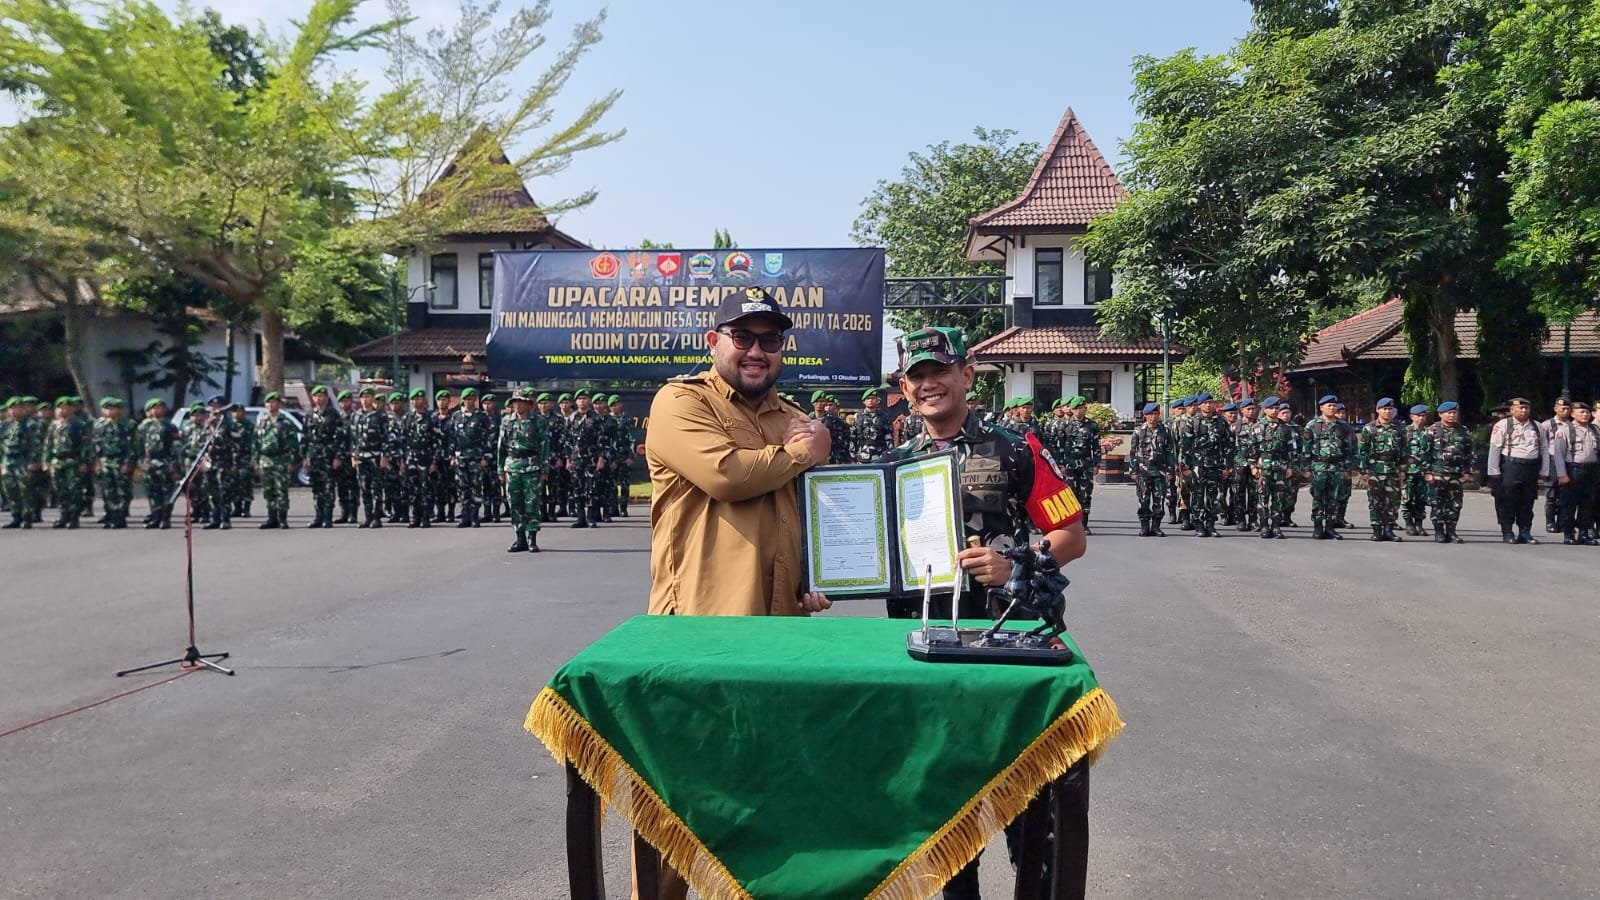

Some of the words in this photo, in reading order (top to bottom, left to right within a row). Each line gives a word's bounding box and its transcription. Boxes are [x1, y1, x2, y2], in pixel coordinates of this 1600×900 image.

[548, 287, 662, 308] UPACARA
[500, 311, 516, 328] TNI
[518, 311, 588, 328] MANUNGGAL
[590, 311, 662, 328] MEMBANGUN
[664, 311, 694, 328] DESA
[813, 313, 825, 330] IV
[827, 313, 840, 330] TA
[842, 313, 872, 331] 2026
[571, 333, 623, 350] KODIM
[575, 355, 620, 364] SATUKAN
[622, 356, 672, 365] LANGKAH,
[798, 357, 823, 366] DESA
[963, 474, 980, 483] TNI
